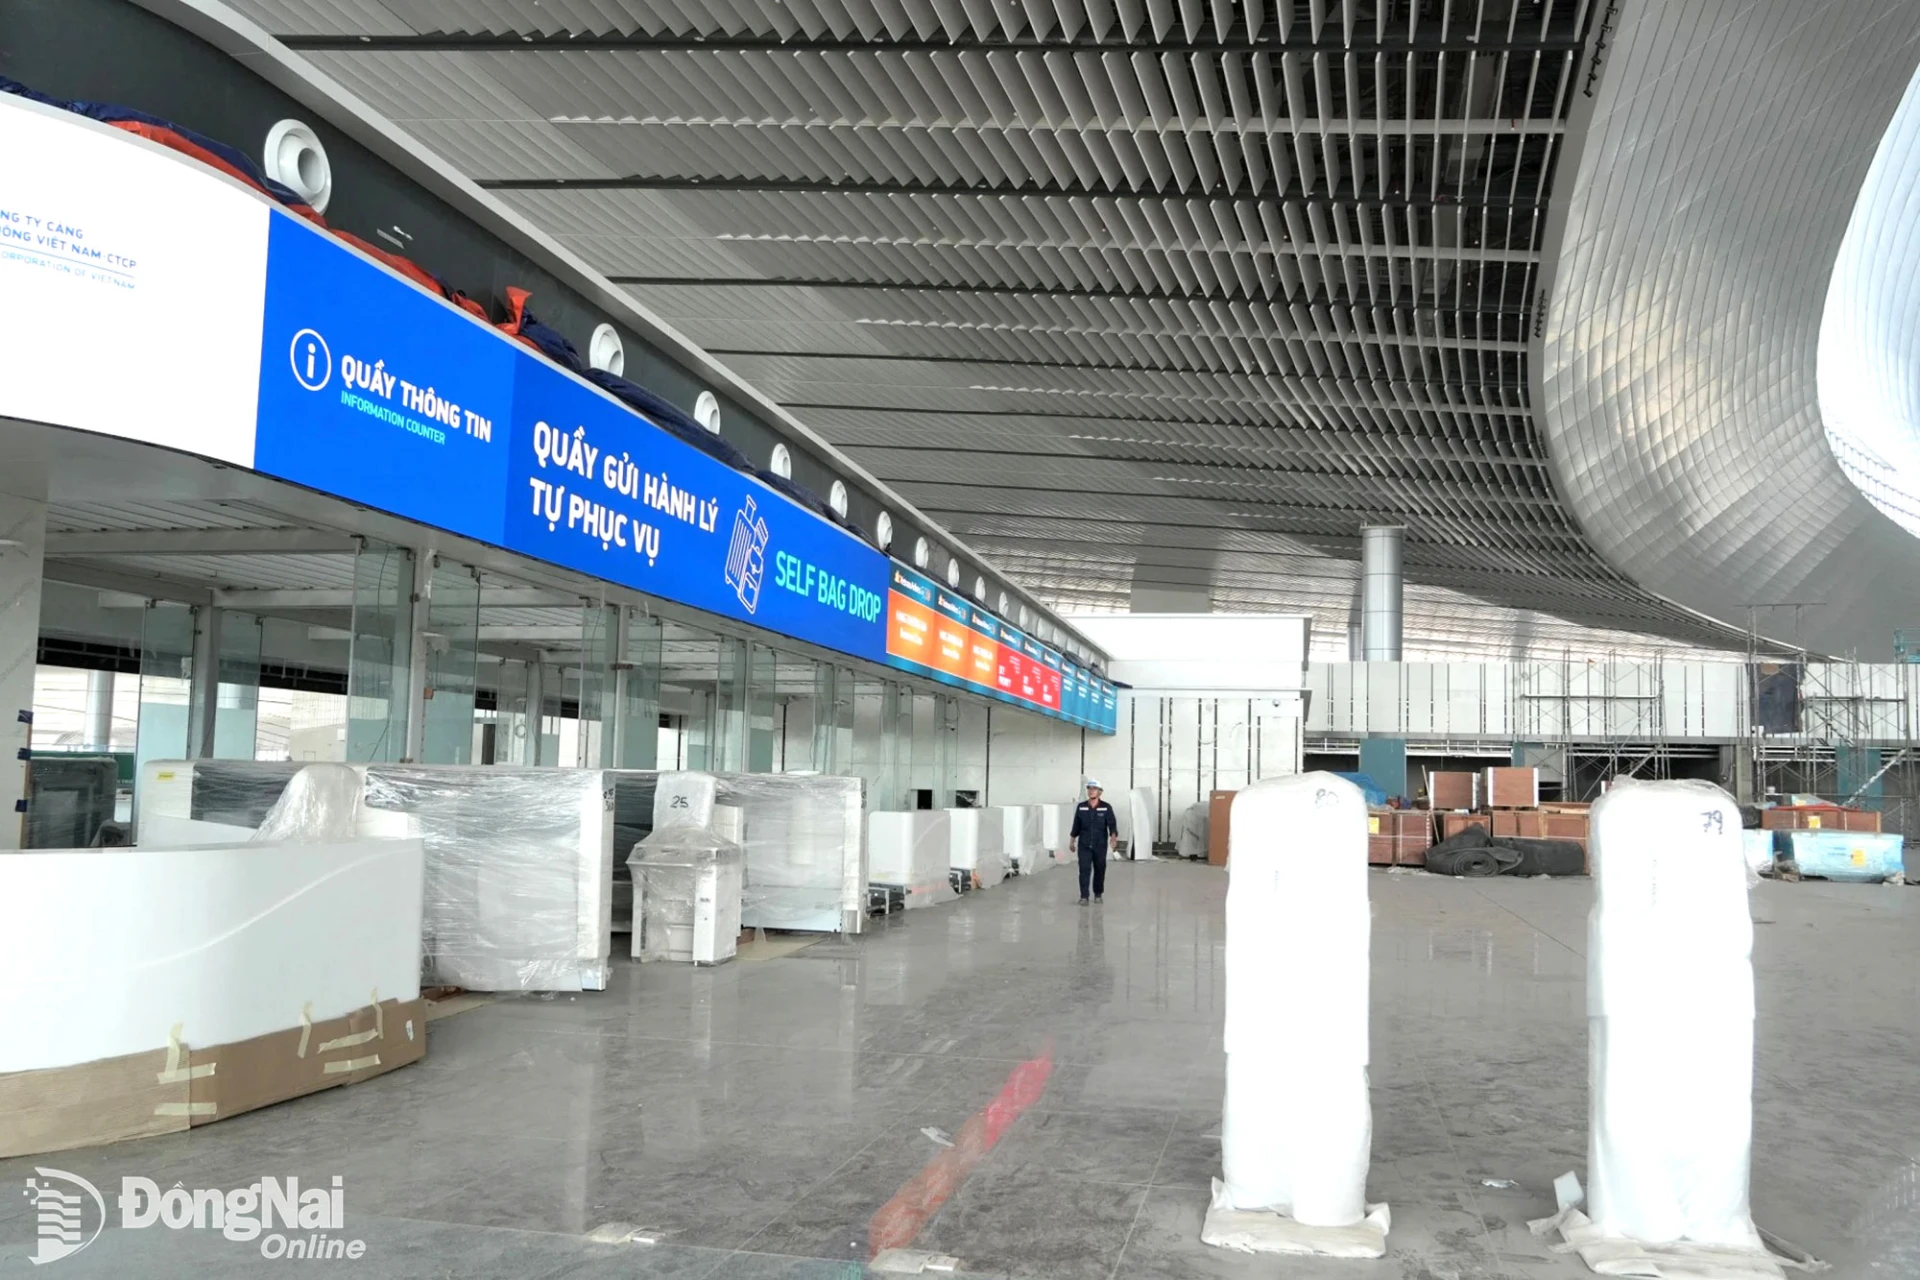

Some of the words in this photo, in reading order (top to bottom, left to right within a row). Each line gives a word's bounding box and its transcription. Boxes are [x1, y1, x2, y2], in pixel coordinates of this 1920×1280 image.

[25, 215, 42, 228] TY
[341, 354, 397, 400] QUẦY
[400, 386, 461, 429] THÔNG
[464, 409, 492, 443] TIN
[341, 390, 405, 429] INFORMATION
[406, 418, 446, 445] COUNTER
[533, 420, 599, 480] QUẦY
[603, 451, 639, 500] GỬI
[643, 472, 696, 525] HÀNH
[699, 497, 719, 533] LÝ
[529, 476, 565, 532] TỰ
[568, 493, 628, 551] PHỤC
[633, 519, 660, 567] VỤ
[774, 550, 816, 597] SELF
[817, 569, 847, 611] BAG
[848, 583, 881, 624] DROP
[670, 795, 689, 809] 25
[1699, 809, 1724, 836] 79
